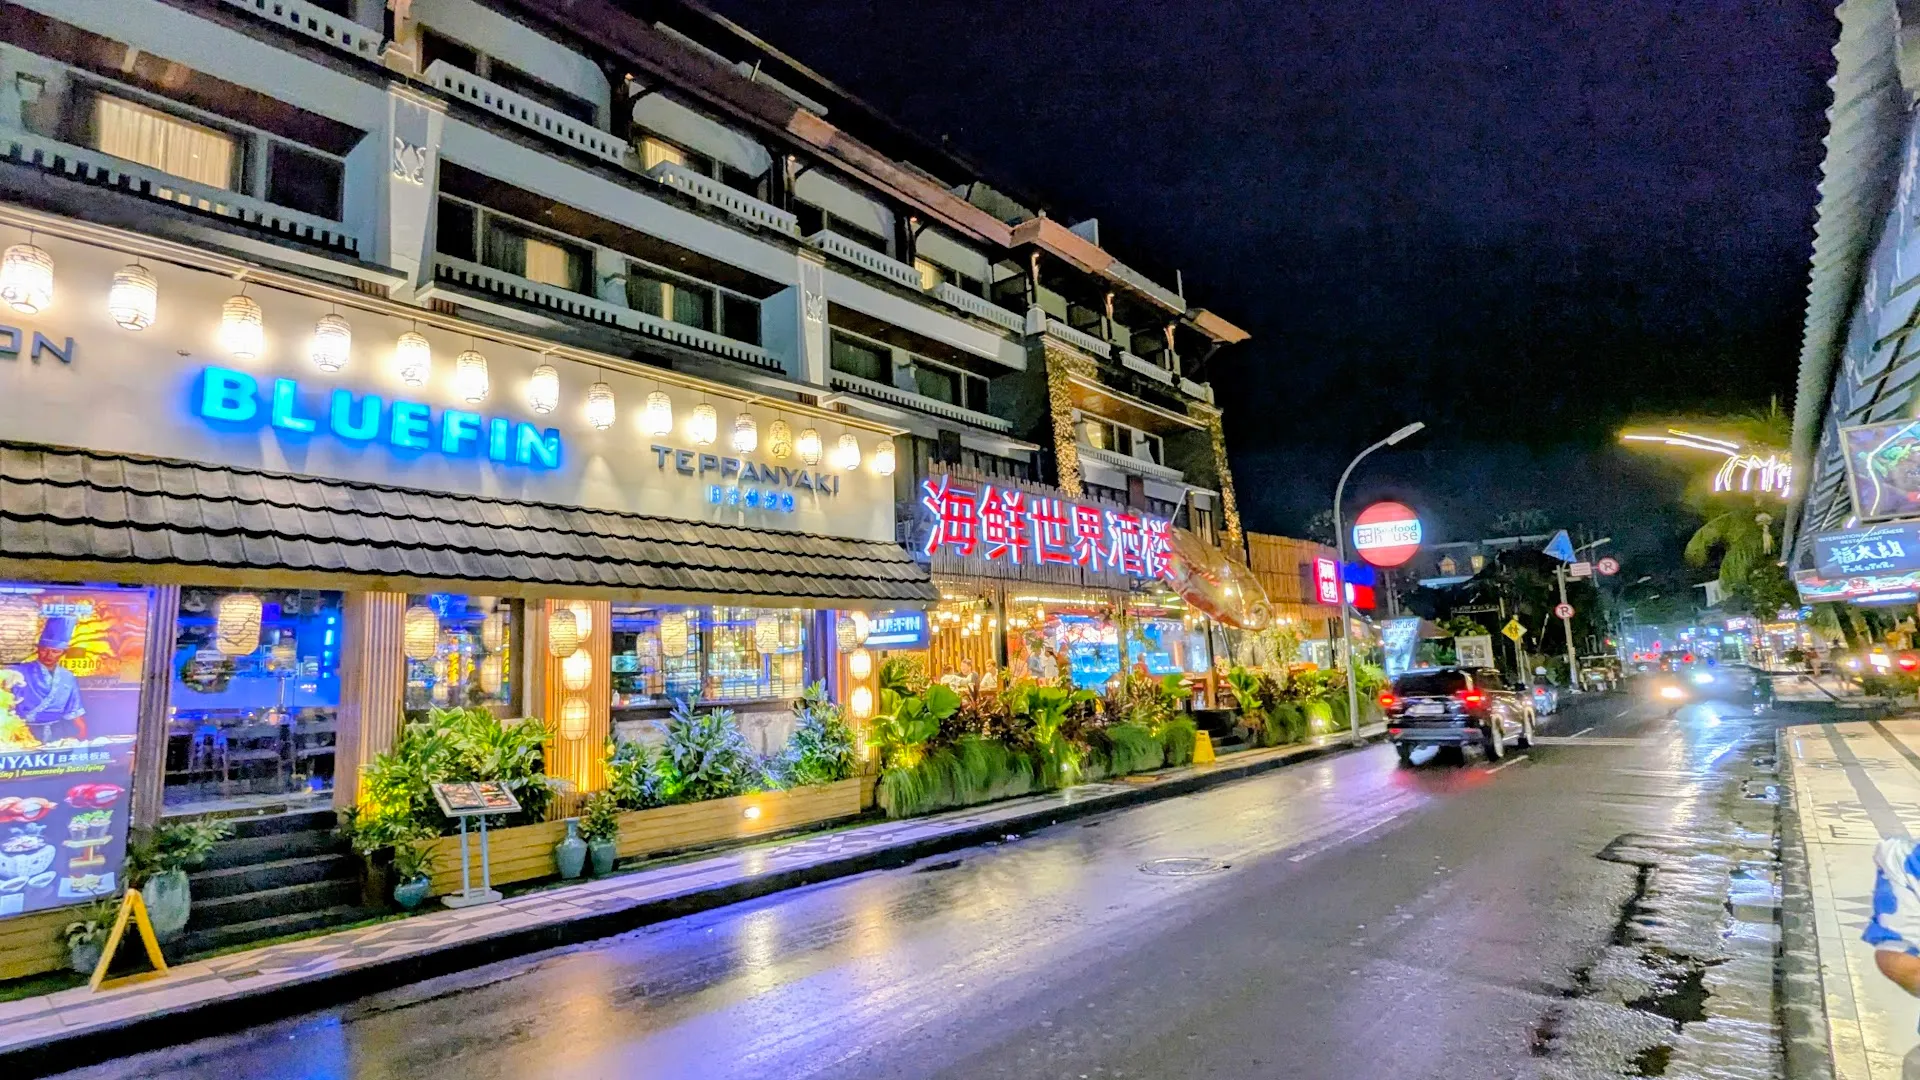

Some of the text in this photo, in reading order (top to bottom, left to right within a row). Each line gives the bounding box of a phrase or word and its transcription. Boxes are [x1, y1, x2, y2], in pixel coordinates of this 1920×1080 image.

[200, 366, 561, 470] BLUEFIN
[650, 444, 840, 497] TEPPANYAKI
[921, 474, 1175, 580] 海鲜世界酒楼
[1374, 527, 1418, 544] huse
[1376, 523, 1417, 534] Sfood
